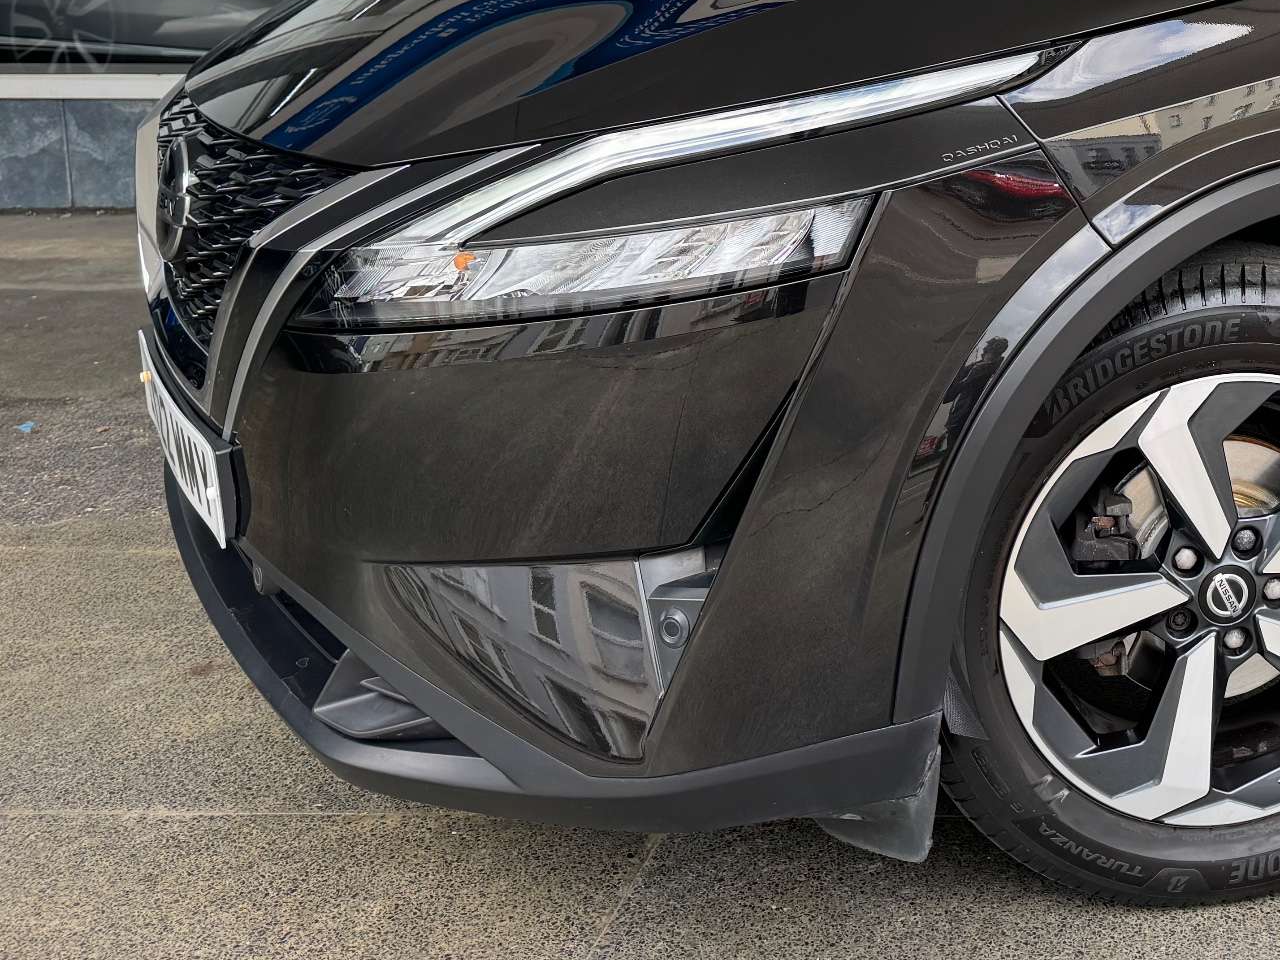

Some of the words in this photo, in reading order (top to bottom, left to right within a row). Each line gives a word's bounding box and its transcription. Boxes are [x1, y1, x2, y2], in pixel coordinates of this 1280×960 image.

[941, 134, 1018, 162] QASHQAI
[1046, 318, 1242, 425] BRIDGESTONE
[1217, 578, 1240, 614] NISSAN
[1037, 821, 1145, 878] TURANZA
